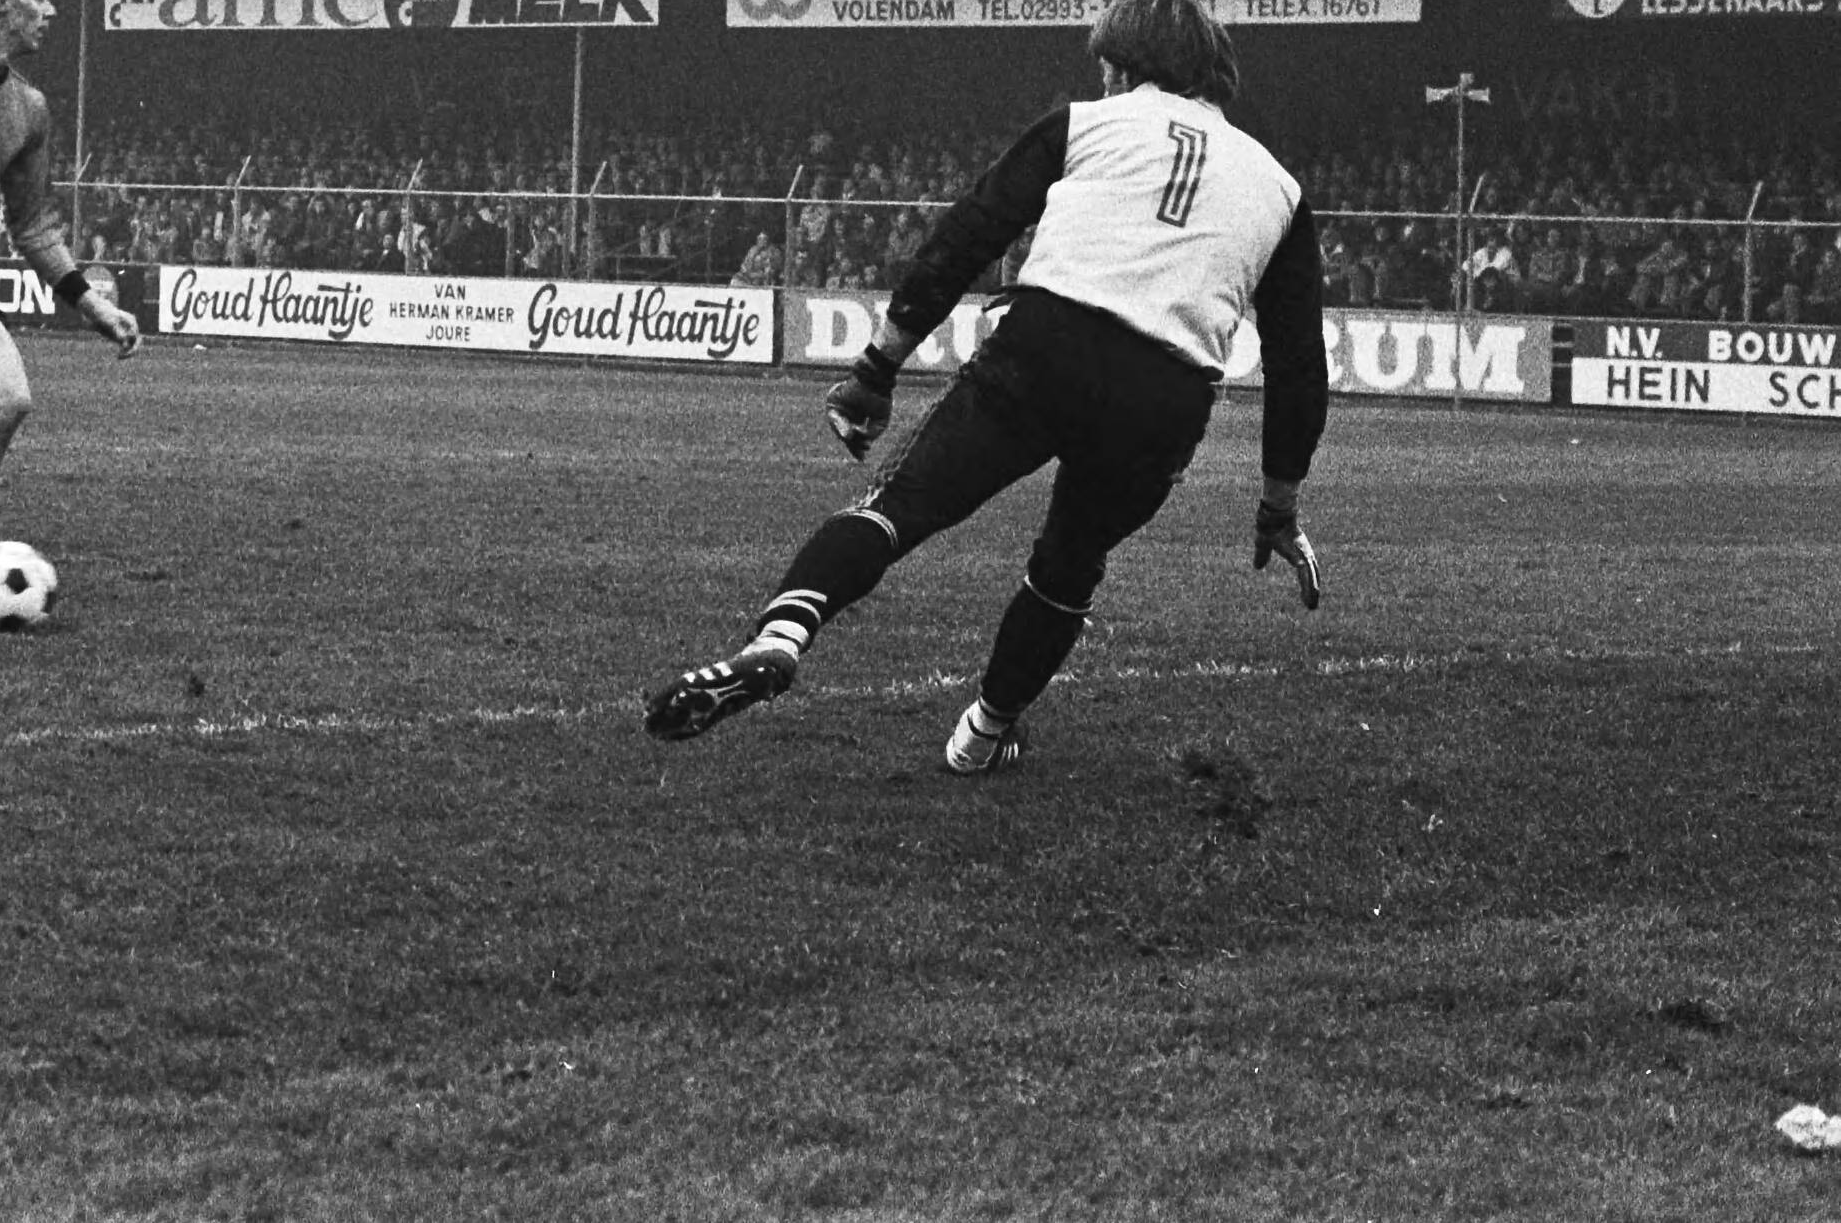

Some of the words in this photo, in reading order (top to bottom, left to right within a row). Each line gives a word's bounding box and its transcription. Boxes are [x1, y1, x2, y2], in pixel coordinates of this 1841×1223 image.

[833, 0, 955, 21] VOLENDAM
[1157, 120, 1207, 228] 1
[171, 270, 253, 328] Goud
[258, 268, 374, 339] Haantje
[434, 283, 465, 302] VAN
[389, 303, 450, 321] HERMAN
[456, 306, 514, 324] KRAMER
[529, 283, 623, 349] Goud
[627, 287, 759, 359] Haantje
[426, 325, 471, 343] JOURE
[1607, 366, 1710, 404] HEIN
